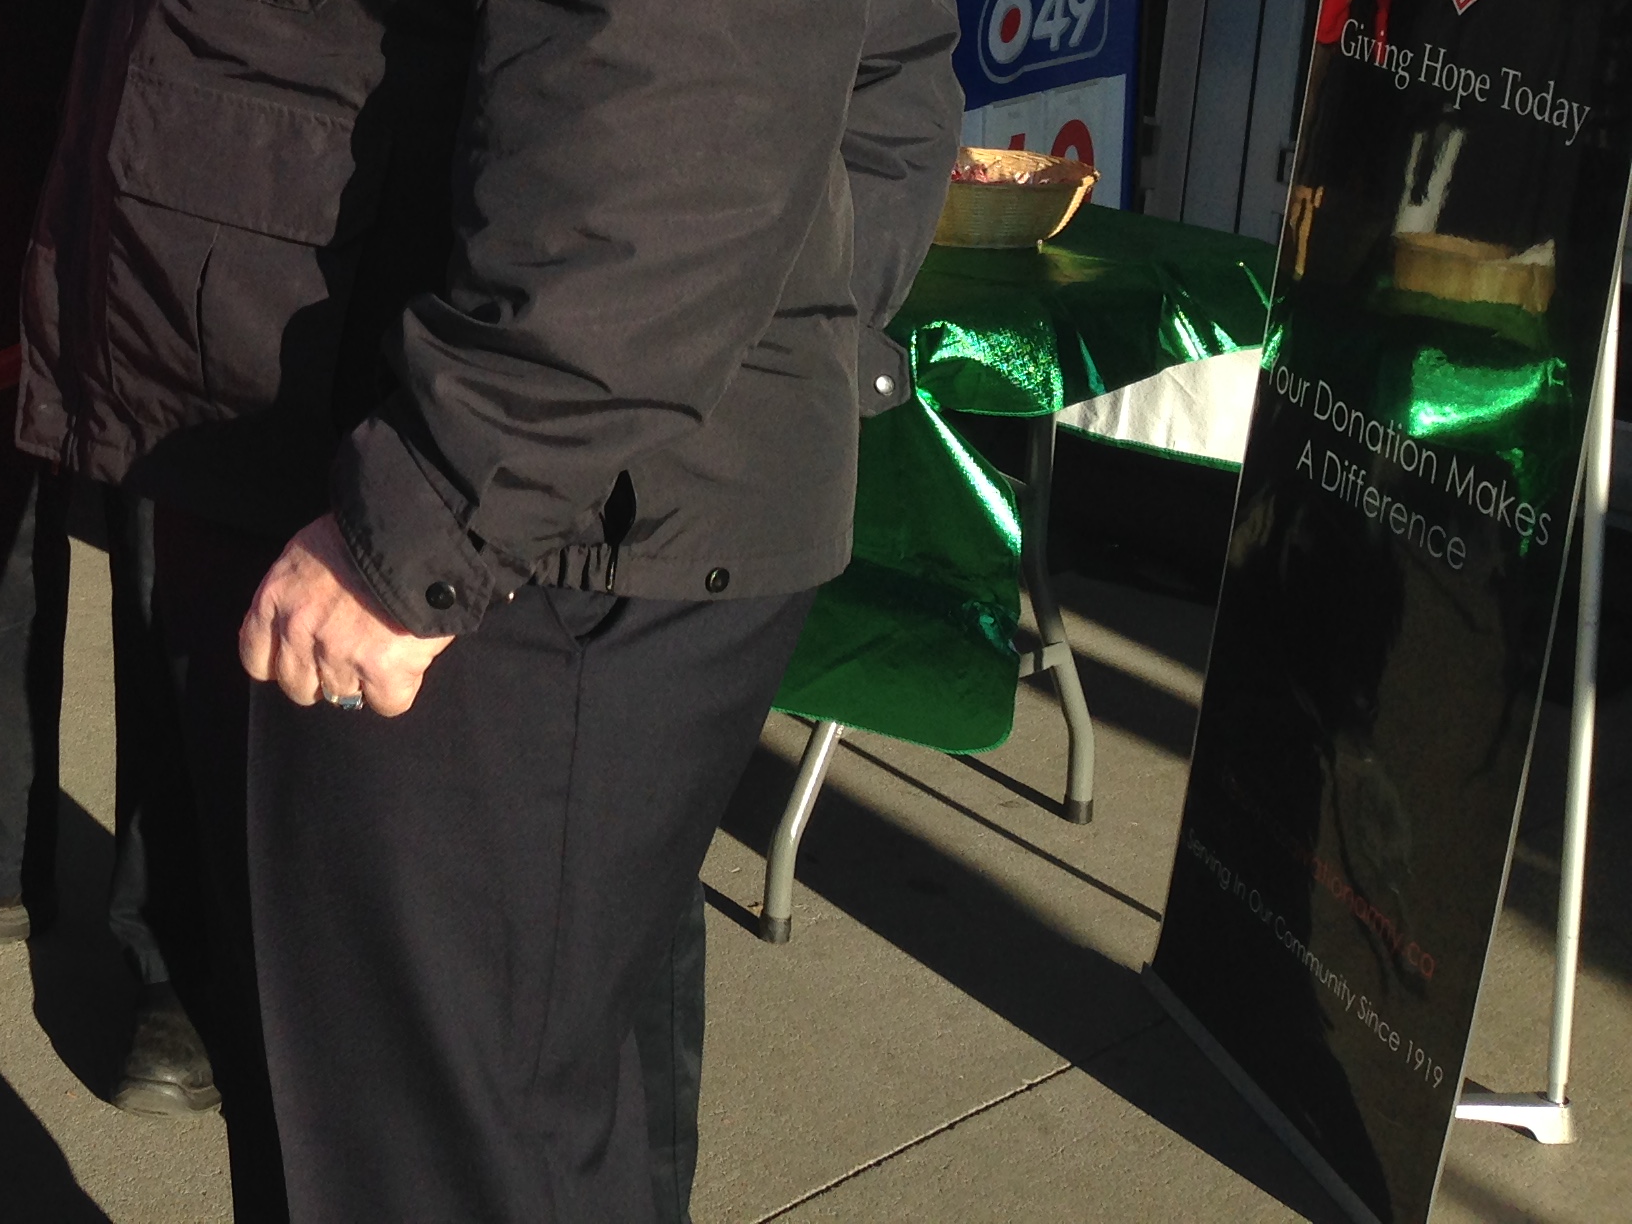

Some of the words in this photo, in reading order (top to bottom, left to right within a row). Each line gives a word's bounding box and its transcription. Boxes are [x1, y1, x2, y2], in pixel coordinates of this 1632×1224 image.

[1340, 17, 1414, 90] Giving
[1418, 42, 1491, 111] Hope
[1499, 67, 1592, 147] Today
[1296, 439, 1313, 480] A
[1321, 449, 1467, 571] Difference
[1313, 379, 1438, 485] Donation
[1445, 454, 1552, 546] Makes
[1187, 827, 1232, 891] Serving
[1234, 874, 1247, 902] In
[1274, 915, 1356, 1012] Community
[1356, 994, 1402, 1052] Since
[1405, 1039, 1444, 1089] 1919
